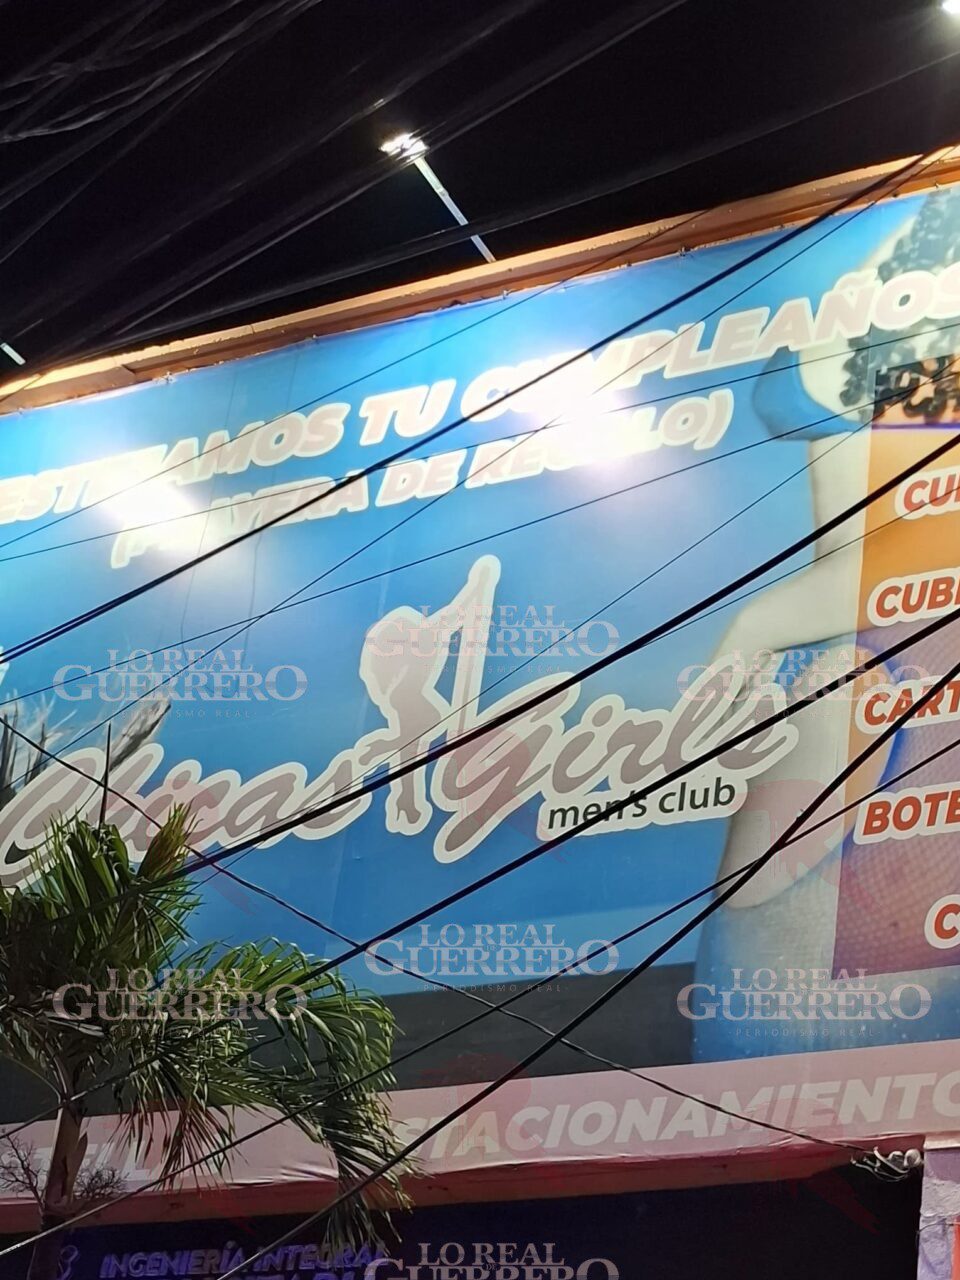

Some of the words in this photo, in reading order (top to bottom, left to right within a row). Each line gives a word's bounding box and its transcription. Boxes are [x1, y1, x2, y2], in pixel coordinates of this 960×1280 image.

[359, 379, 456, 446] TU
[375, 450, 464, 507] DE
[548, 789, 648, 829] men's
[658, 777, 736, 814] club
[99, 1241, 250, 1278] INGENIERÍA
